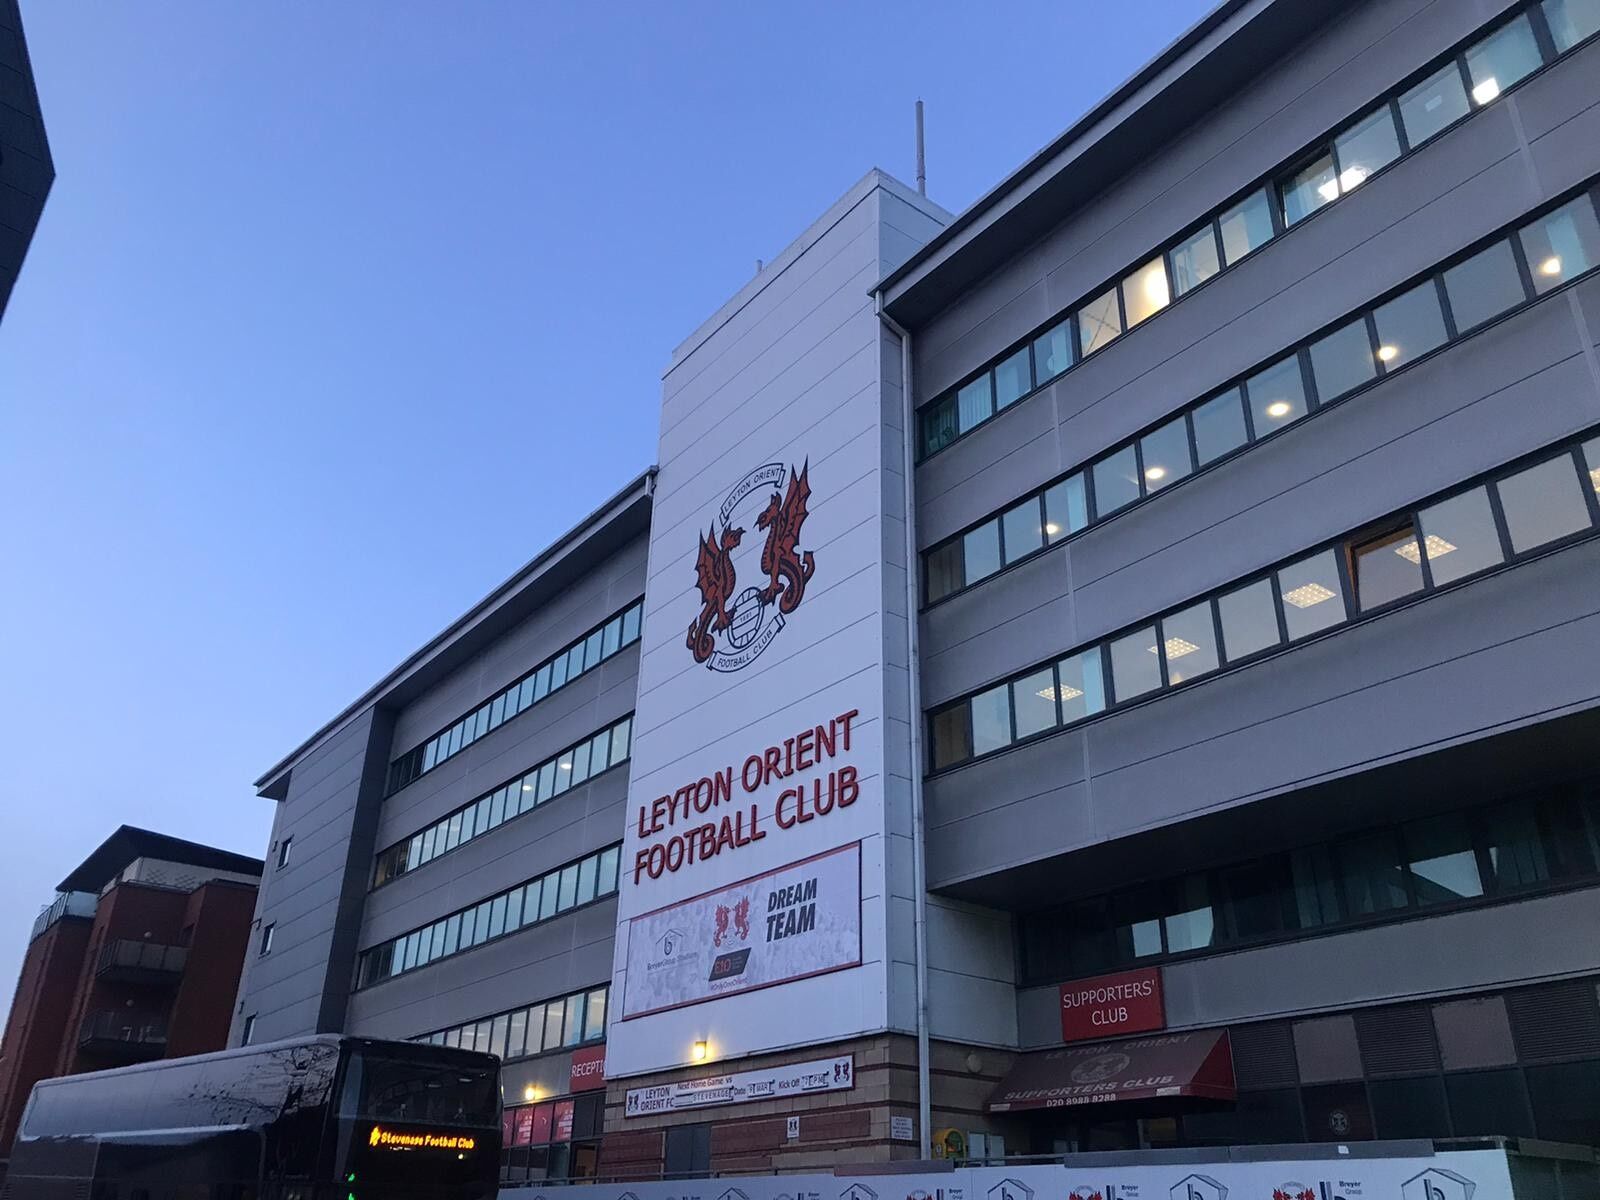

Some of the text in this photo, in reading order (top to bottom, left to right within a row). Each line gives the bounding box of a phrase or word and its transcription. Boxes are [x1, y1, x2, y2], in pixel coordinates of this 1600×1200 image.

[724, 467, 780, 512] LEYTON ORIENT
[717, 629, 772, 668] FOOTBALL CLUB
[638, 709, 859, 839] LEYTON ORIENT
[633, 765, 860, 885] FOOTBALL CLUB
[767, 878, 818, 912] DREAM
[766, 902, 816, 943] TEAM
[1091, 1007, 1128, 1026] CLUB
[1124, 1034, 1192, 1050] ORIENT
[571, 1059, 606, 1077] RECEPTI
[645, 1086, 670, 1099] LEYTON
[690, 1080, 706, 1089] Home
[708, 1078, 724, 1087] Game
[779, 1080, 790, 1089] Kick
[792, 1079, 800, 1088] Off
[1004, 1075, 1175, 1100] SUPPORTERS CLUB
[640, 1097, 675, 1111] ORIENT FC
[424, 1134, 457, 1148] Football
[457, 1137, 474, 1149] Club
[1338, 1180, 1361, 1188] Breyer
